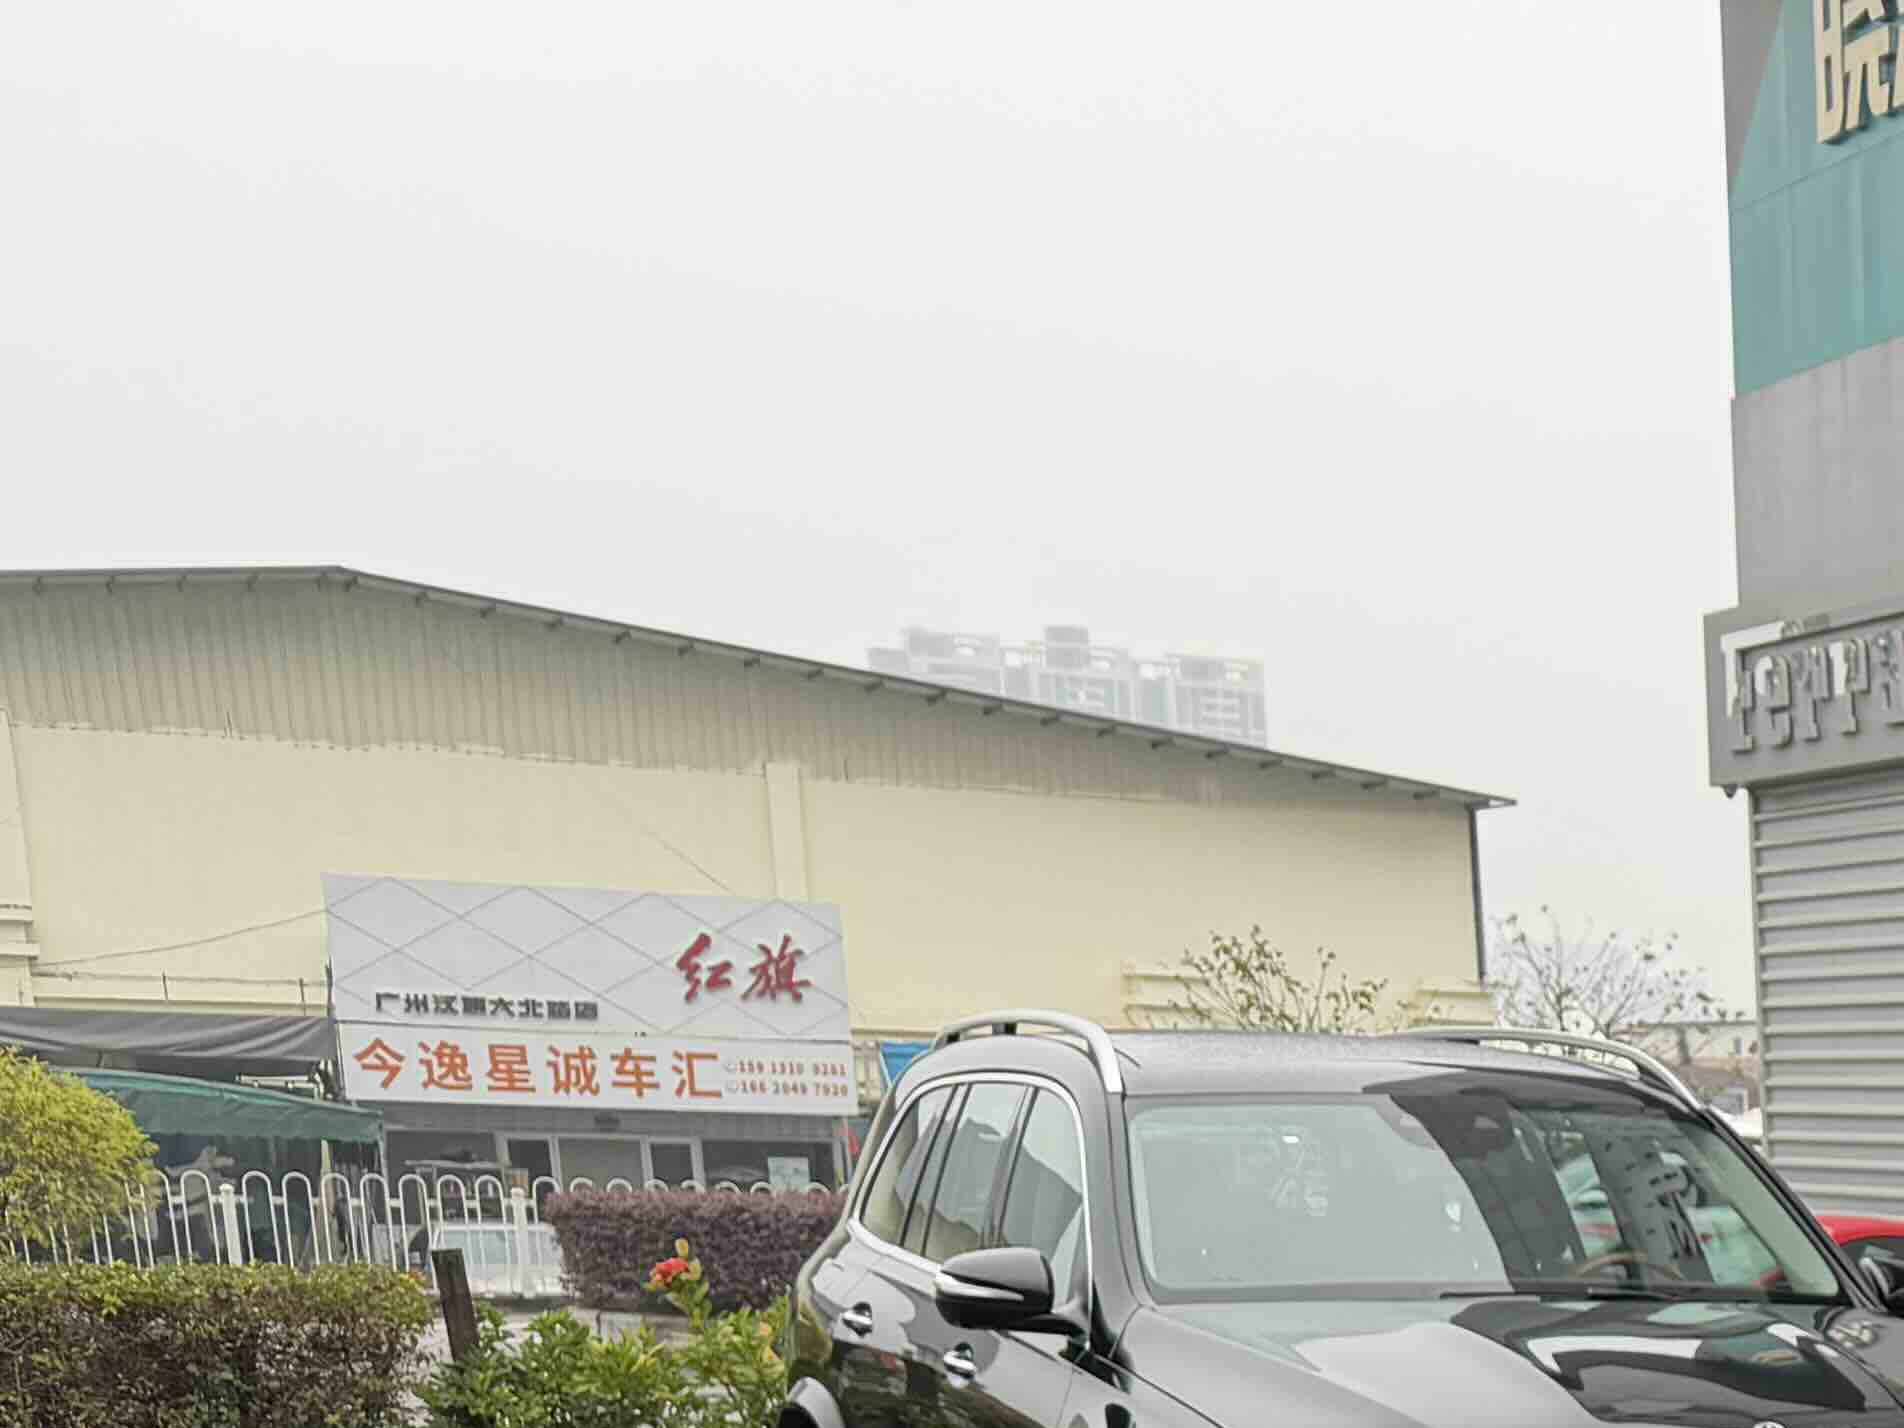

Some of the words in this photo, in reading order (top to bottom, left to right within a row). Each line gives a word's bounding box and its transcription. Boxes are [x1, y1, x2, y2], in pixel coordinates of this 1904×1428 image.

[675, 932, 814, 1004] 红旗
[354, 1037, 723, 1099] 今逸星诚车汇
